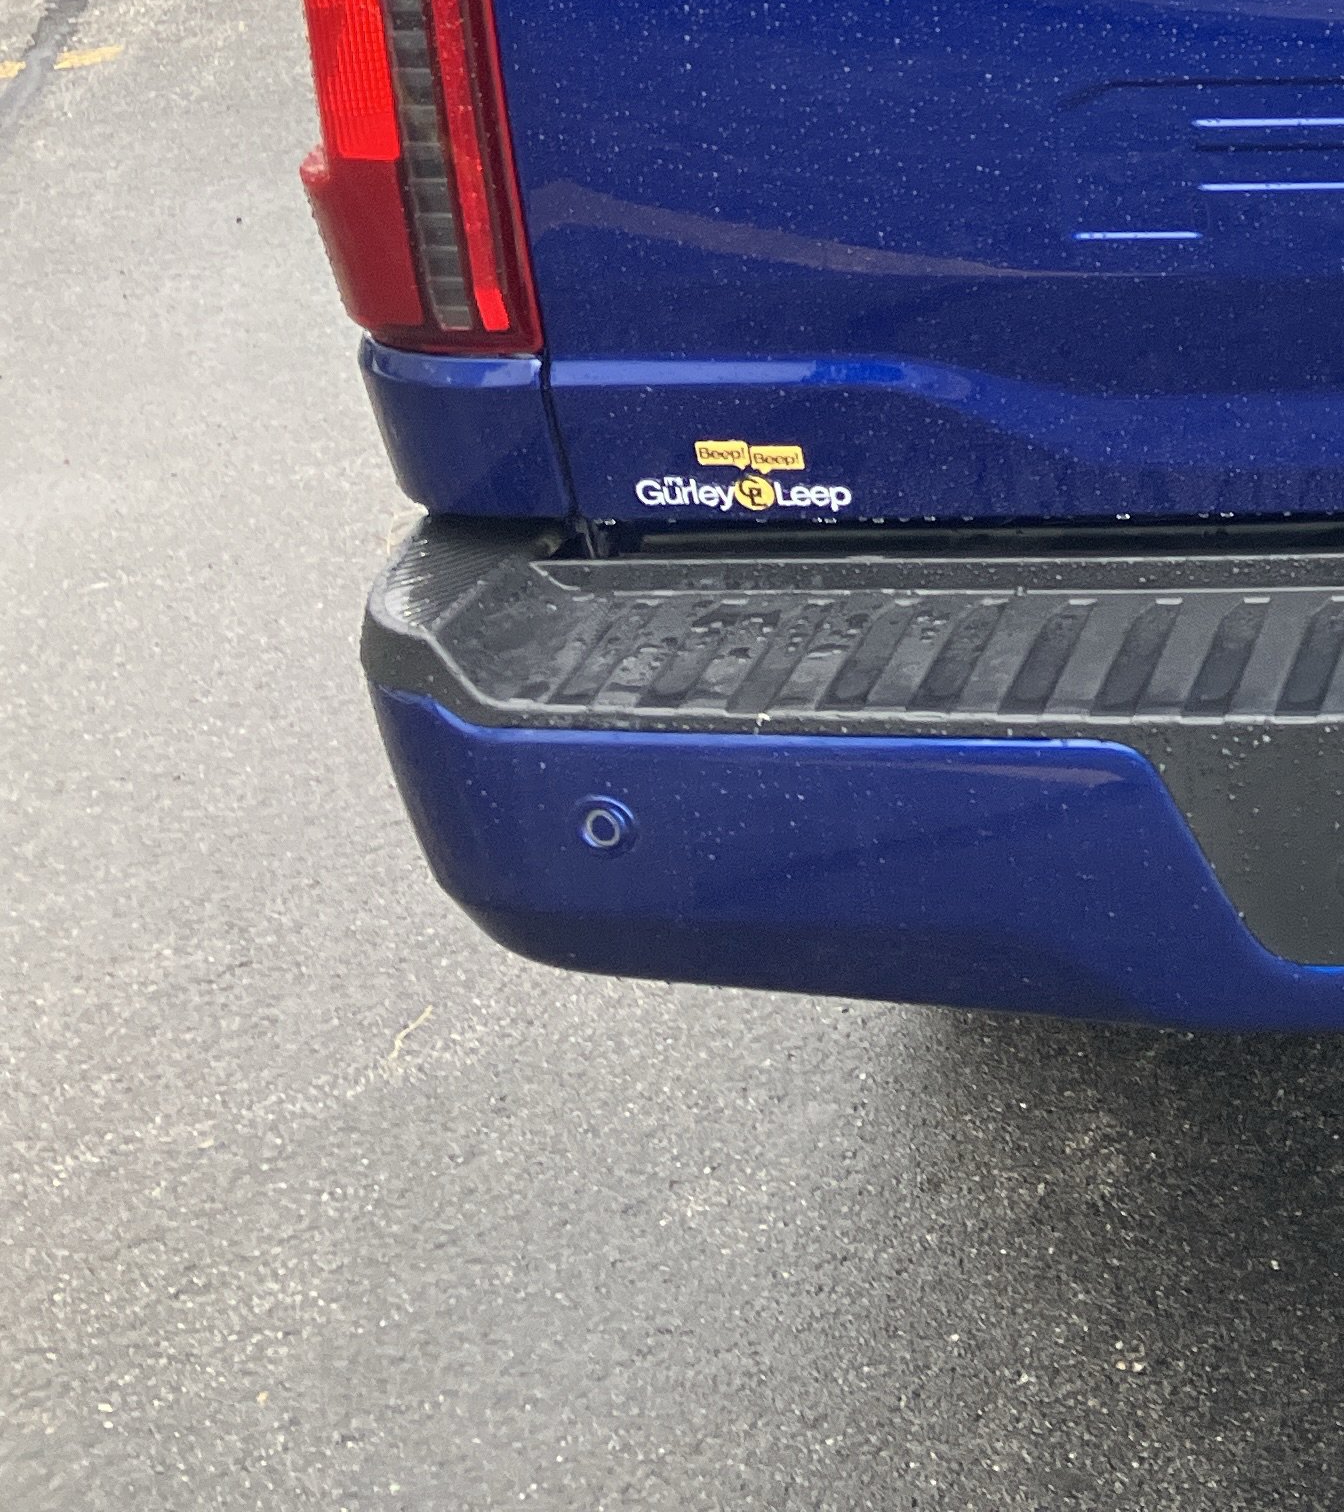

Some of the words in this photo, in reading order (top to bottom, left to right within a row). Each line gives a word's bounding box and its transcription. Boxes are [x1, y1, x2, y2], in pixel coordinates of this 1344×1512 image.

[698, 446, 746, 461] Beep!
[753, 451, 800, 467] Beep!
[774, 482, 852, 511] Leep
